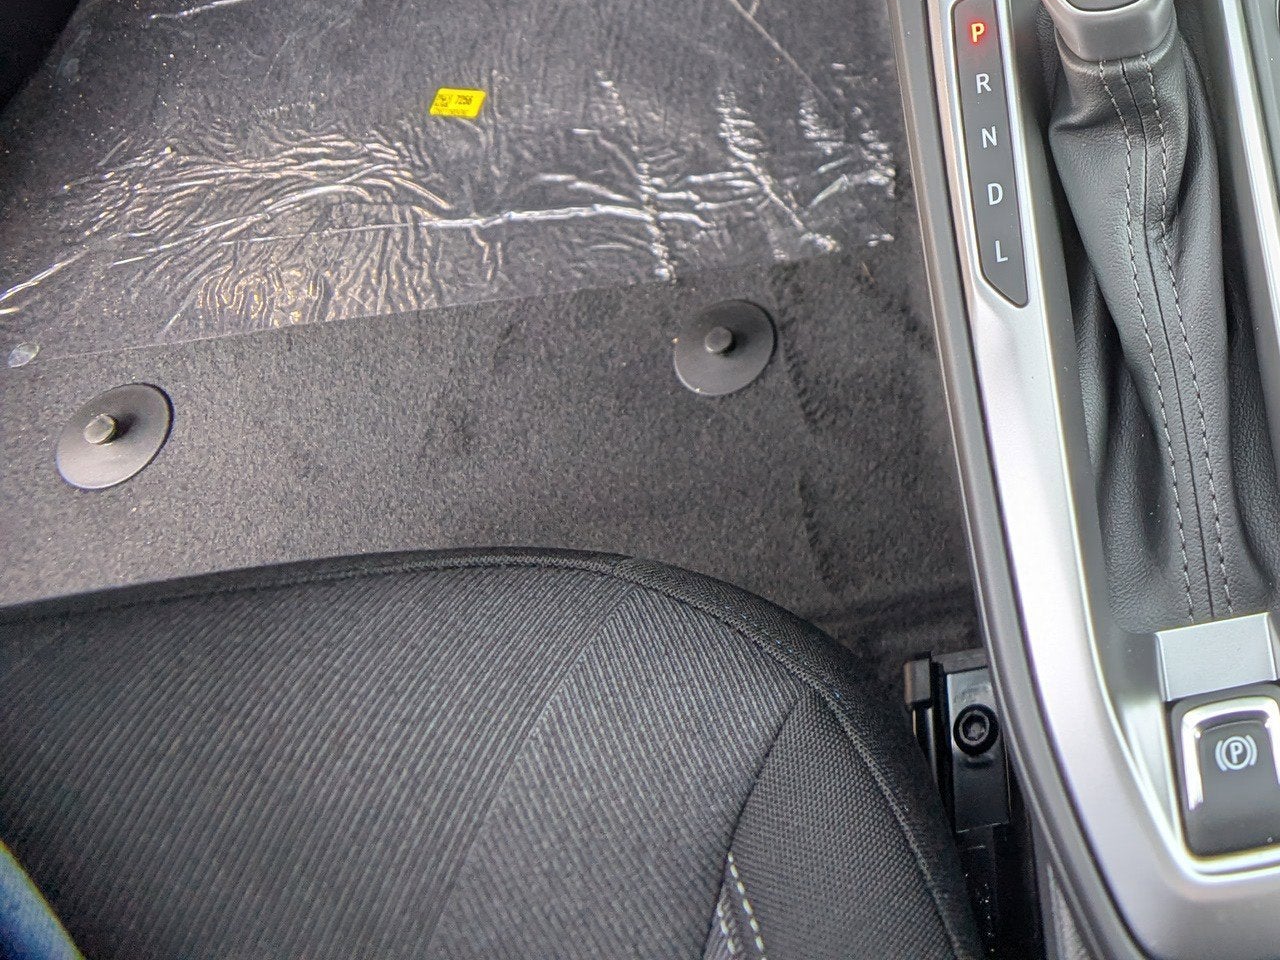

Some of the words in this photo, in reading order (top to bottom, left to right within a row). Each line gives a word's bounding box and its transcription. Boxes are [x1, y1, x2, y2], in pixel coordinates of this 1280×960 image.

[971, 22, 985, 43] P
[975, 73, 992, 94] R
[981, 126, 998, 149] N
[987, 182, 1004, 206] D
[995, 240, 1009, 263] L
